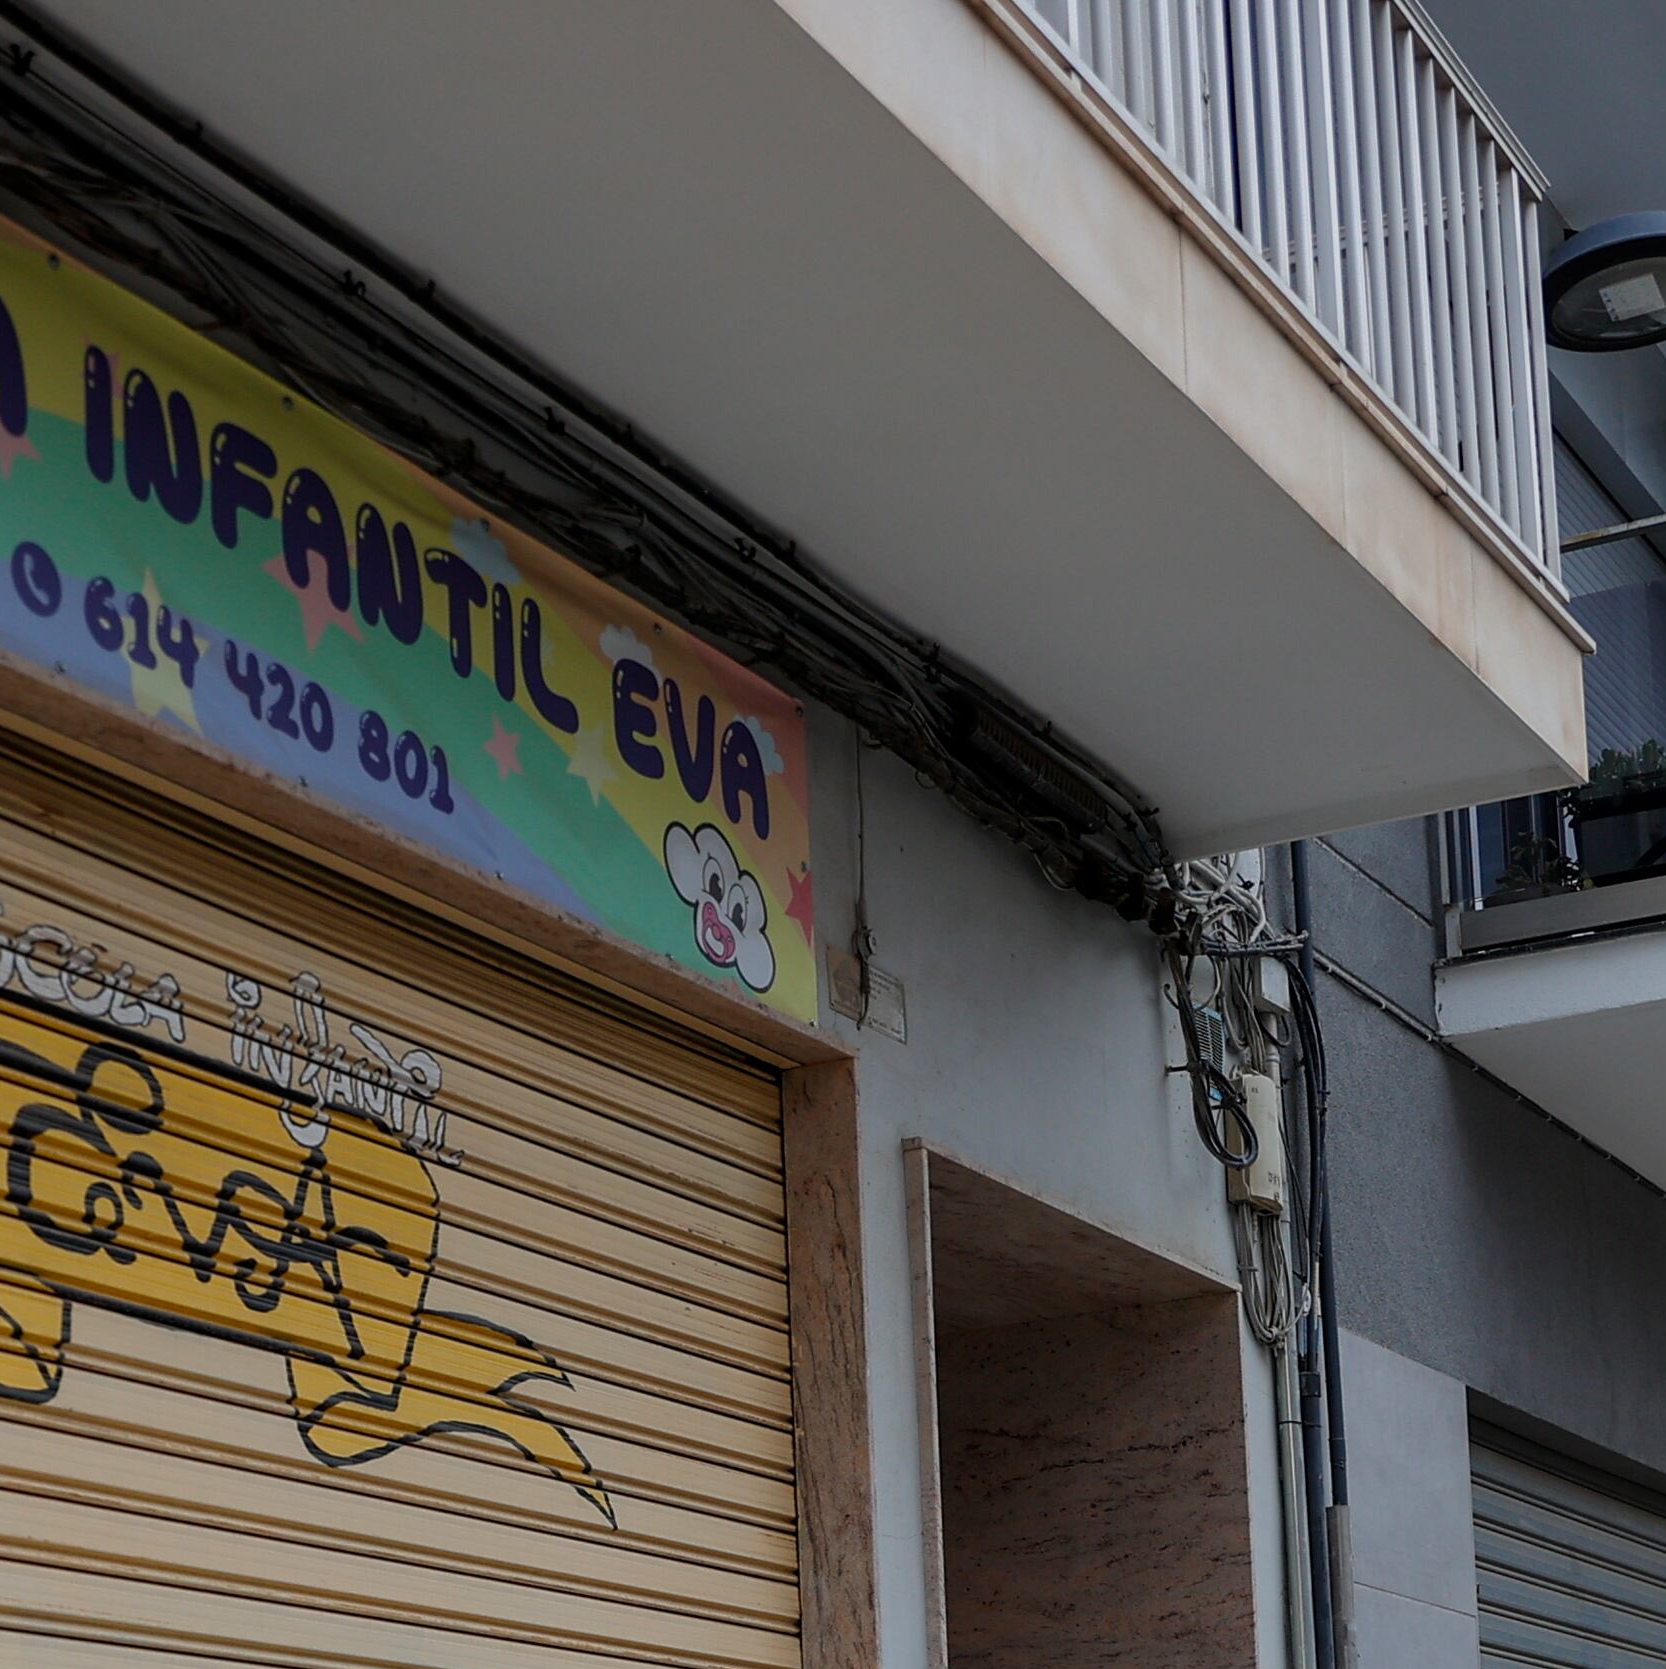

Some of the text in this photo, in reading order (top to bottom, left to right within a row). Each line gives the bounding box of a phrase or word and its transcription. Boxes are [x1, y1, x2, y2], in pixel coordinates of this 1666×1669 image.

[83, 576, 455, 815] 614 420 801
[84, 345, 579, 734] INFANTIL
[611, 657, 770, 841] EVA
